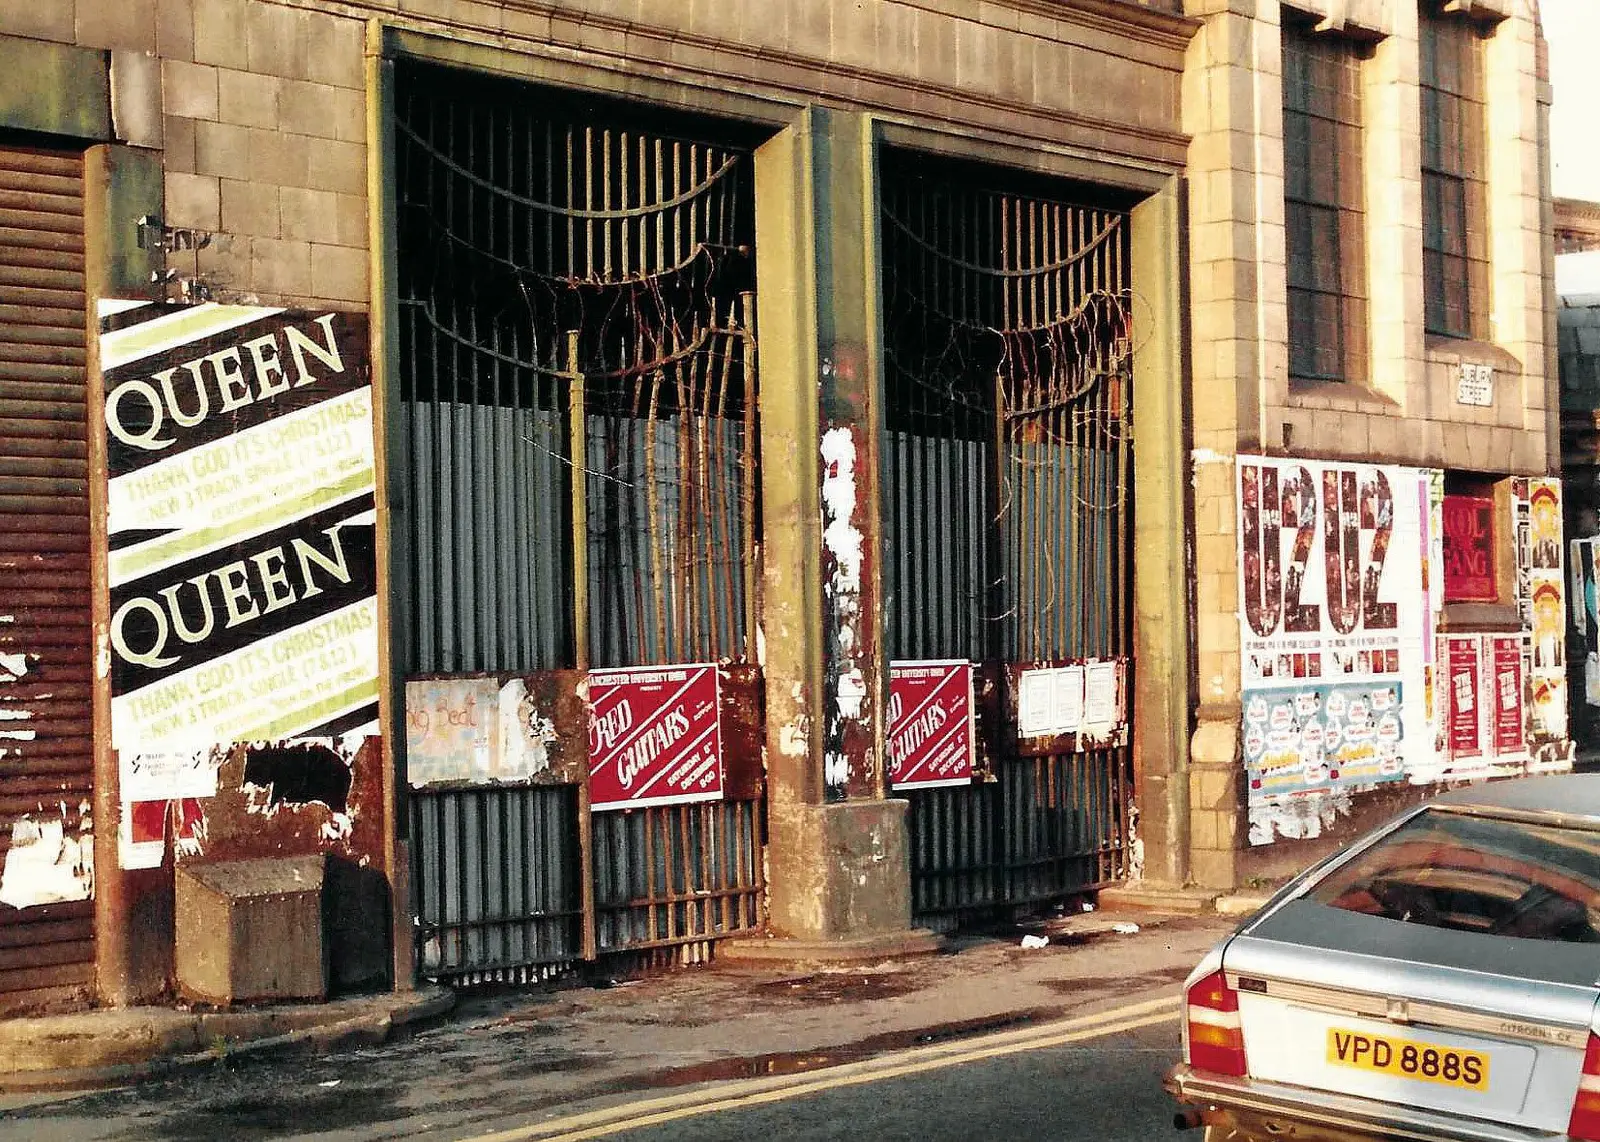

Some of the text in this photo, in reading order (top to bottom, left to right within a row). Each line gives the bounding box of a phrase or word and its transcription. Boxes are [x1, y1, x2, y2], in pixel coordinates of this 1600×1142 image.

[105, 313, 345, 450] QUEEN
[192, 446, 231, 478] GOD
[268, 398, 368, 450] CHRISTMAS
[1241, 465, 1321, 637] U2
[1322, 468, 1398, 635] U2
[1444, 507, 1485, 538] OOL
[110, 527, 352, 668] QUEEN
[127, 681, 194, 722] THANK
[195, 661, 236, 695] GOD
[271, 606, 373, 661] CHRISTMAS
[589, 699, 633, 757] RED
[617, 704, 690, 790] GUITARS
[890, 699, 947, 774] GUITARS
[1335, 1032, 1482, 1085] VPD 888S
